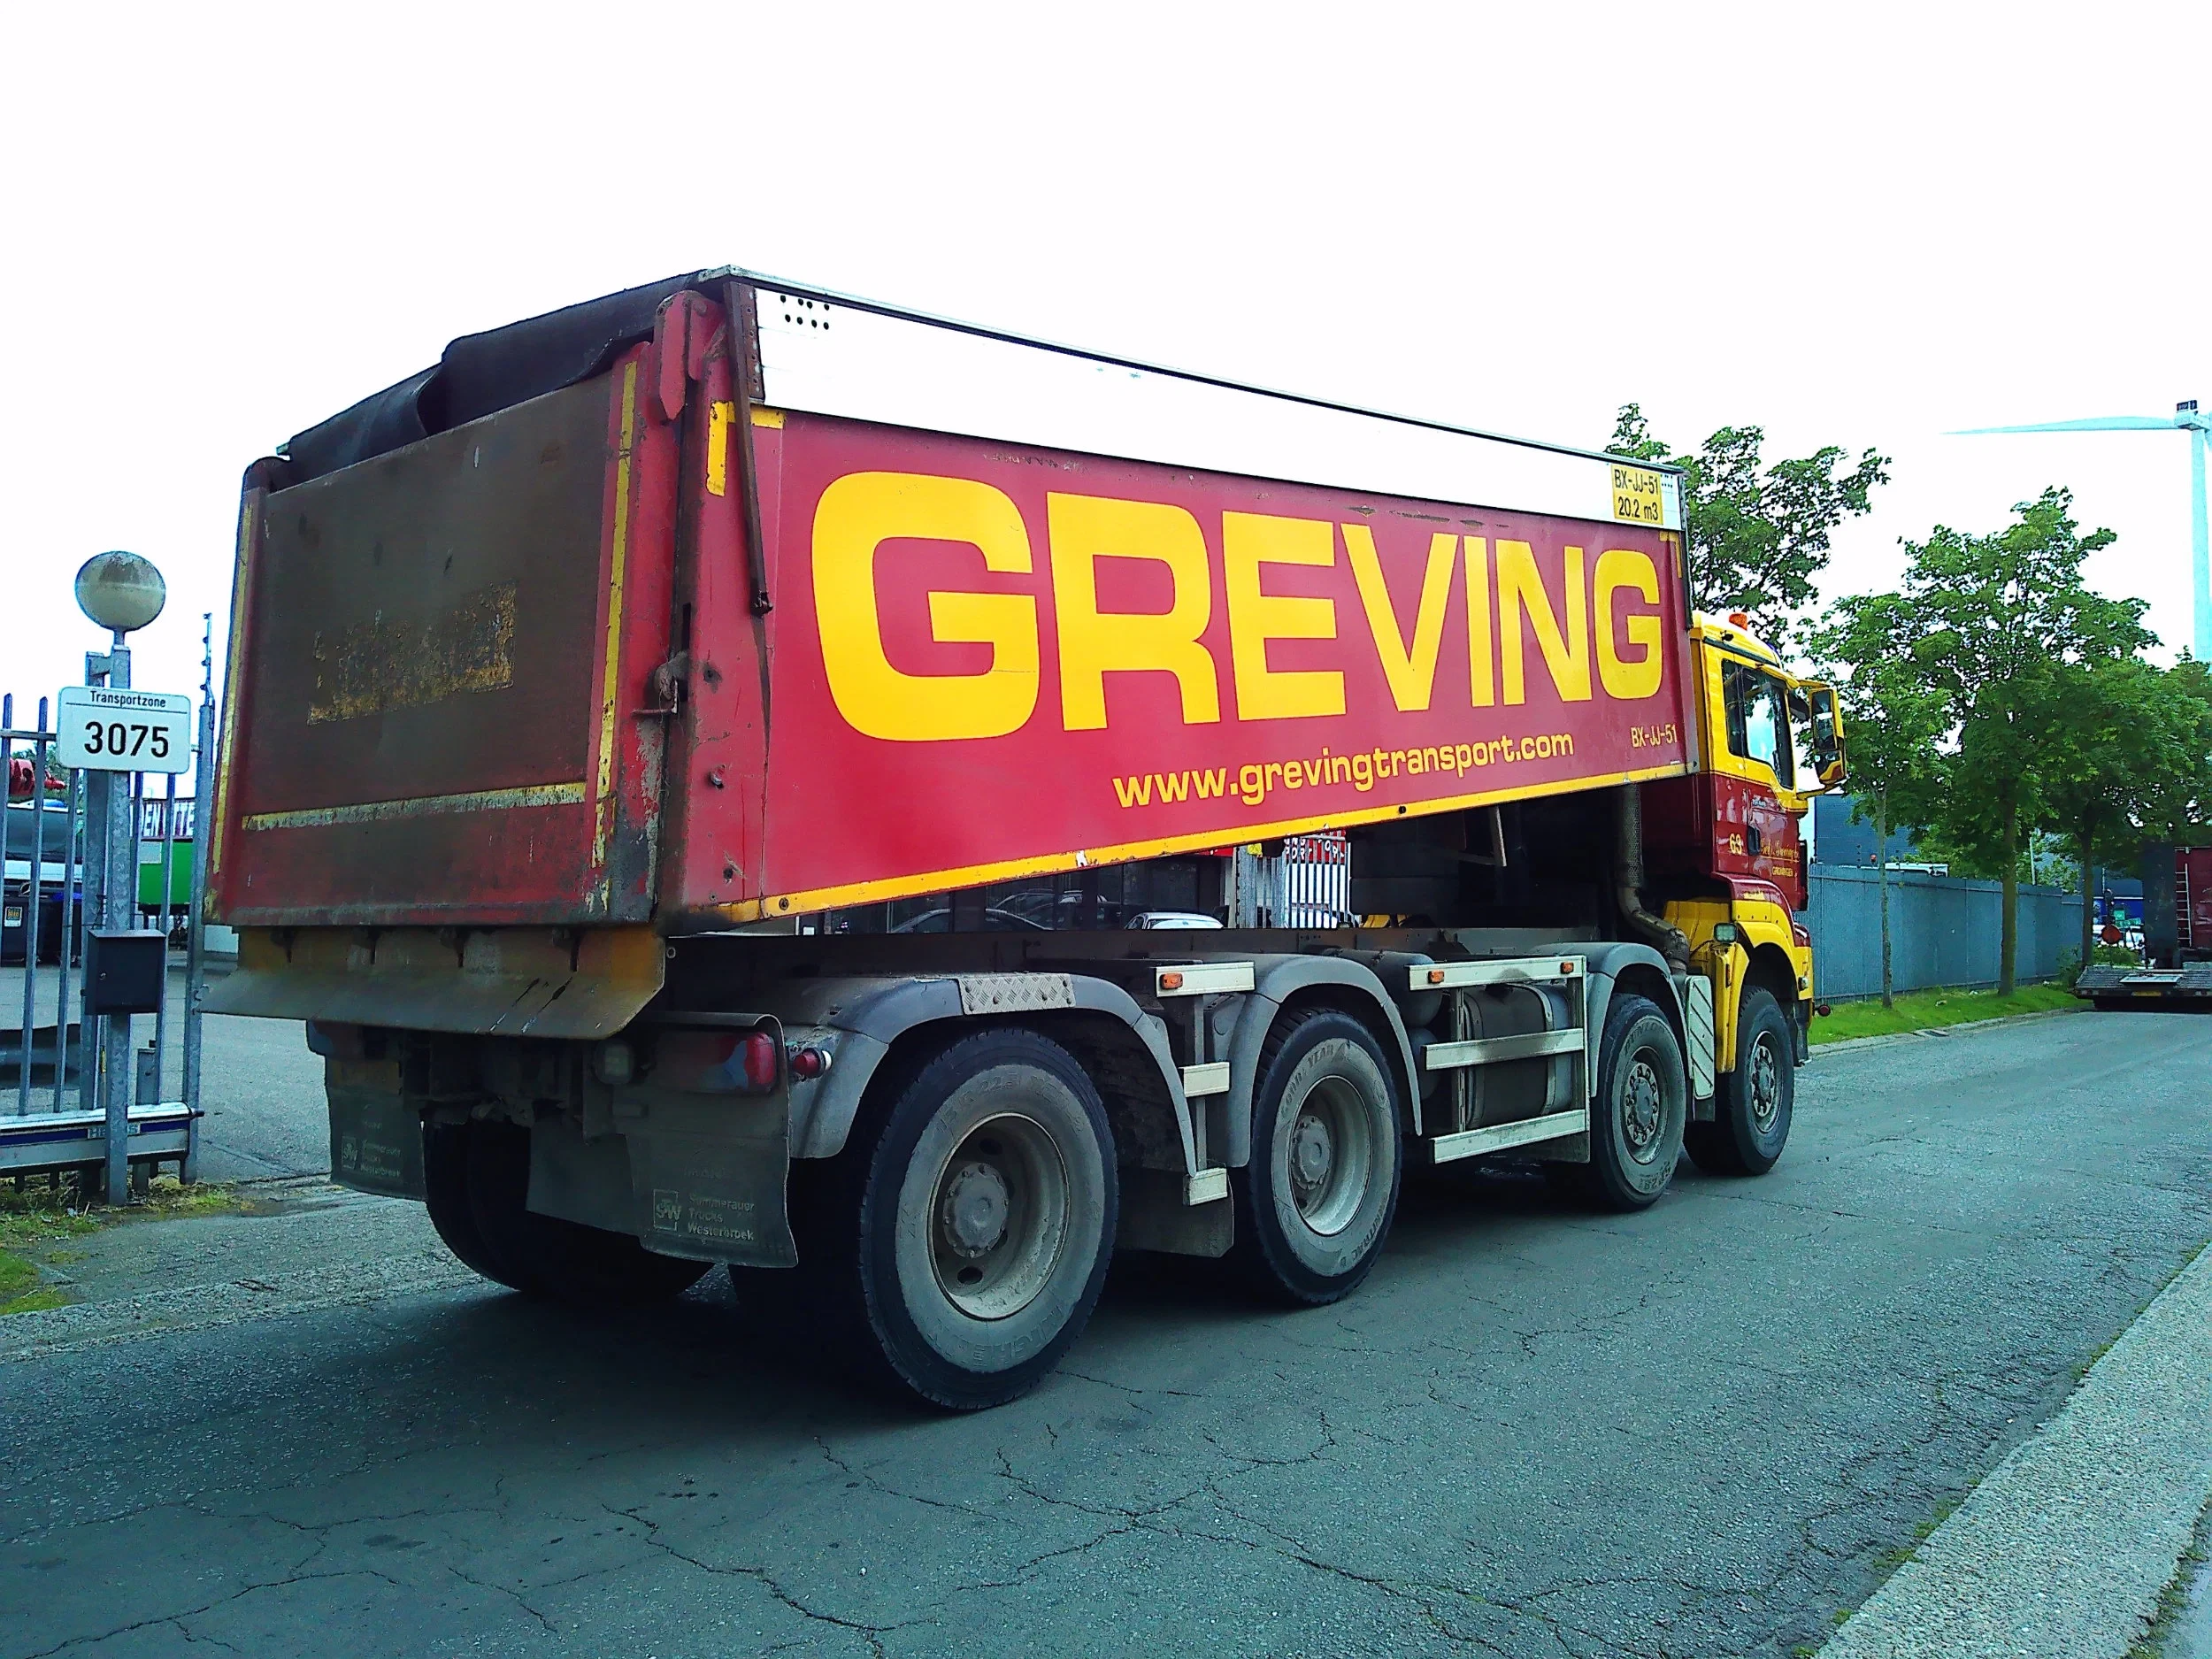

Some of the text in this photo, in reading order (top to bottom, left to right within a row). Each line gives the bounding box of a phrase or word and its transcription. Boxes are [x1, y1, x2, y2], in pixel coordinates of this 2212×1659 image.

[1614, 469, 1659, 495] BX-JJ-51
[1617, 495, 1659, 520] 20.2 m3
[811, 471, 1663, 741] GREVING
[90, 690, 166, 708] Transportzone
[84, 721, 169, 758] 3075
[1630, 724, 1678, 748] BX-JJ-51
[1113, 733, 1573, 807] www.grevingtransport.com
